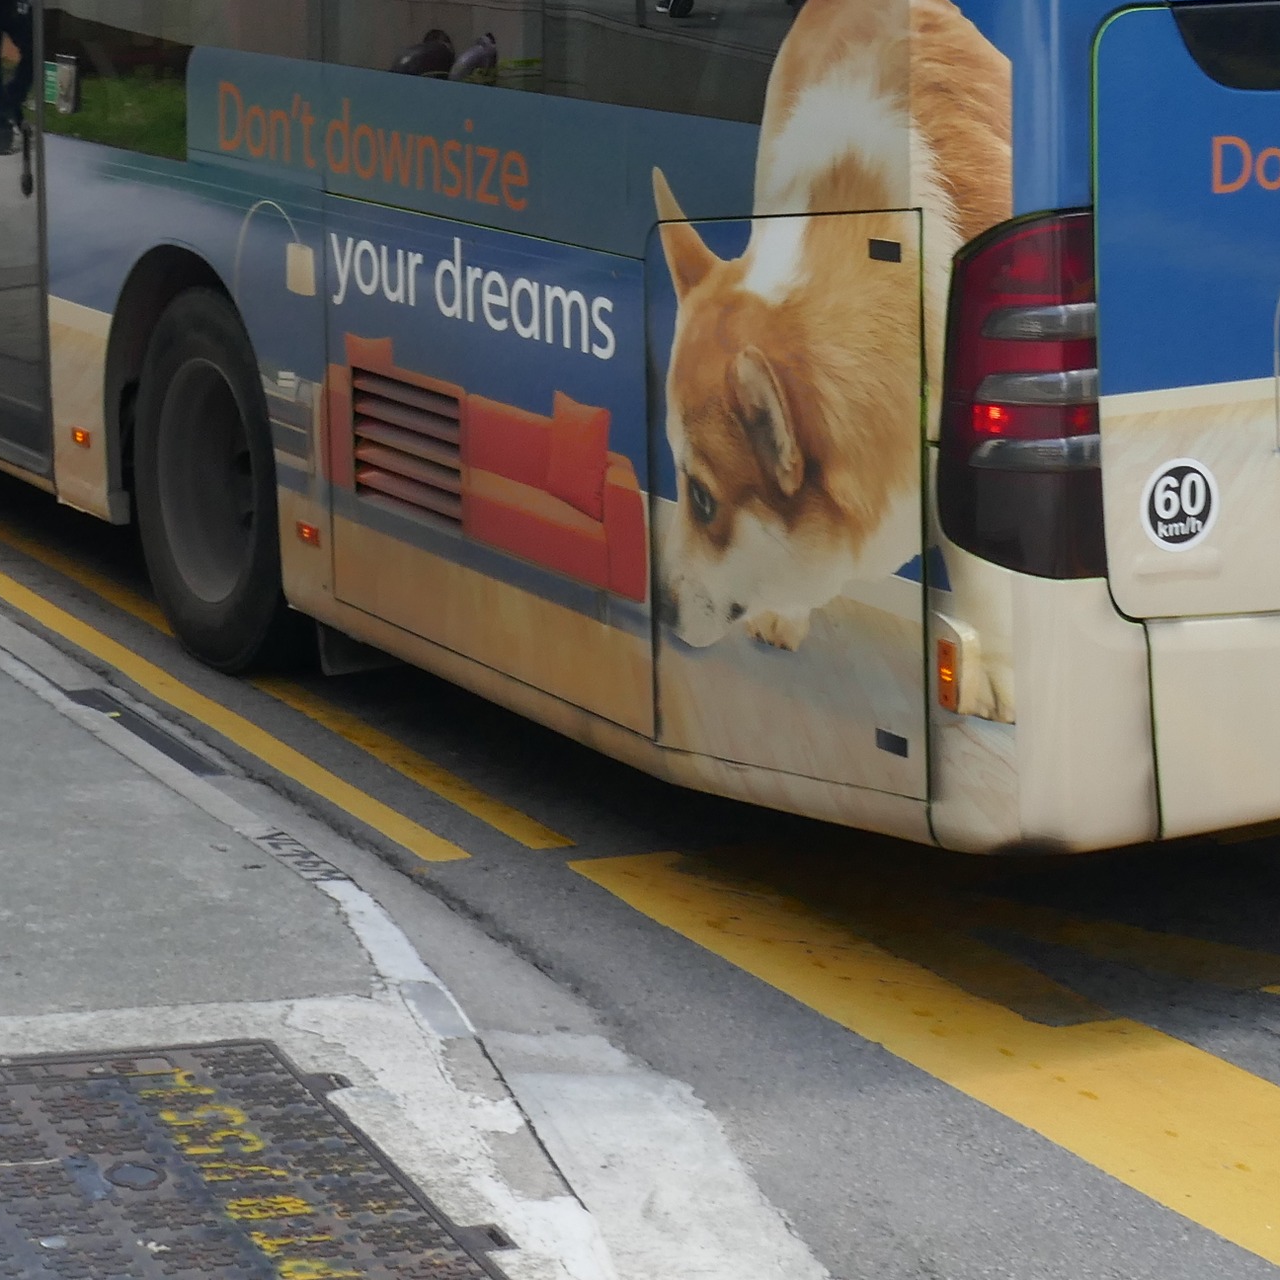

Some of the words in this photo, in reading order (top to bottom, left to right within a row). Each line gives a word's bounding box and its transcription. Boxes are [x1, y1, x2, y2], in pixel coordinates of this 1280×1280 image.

[219, 80, 316, 169] Don't
[324, 98, 530, 211] downsize
[329, 231, 424, 306] your
[433, 236, 617, 361] dreams
[1153, 472, 1207, 520] 60
[1156, 516, 1203, 538] km/h
